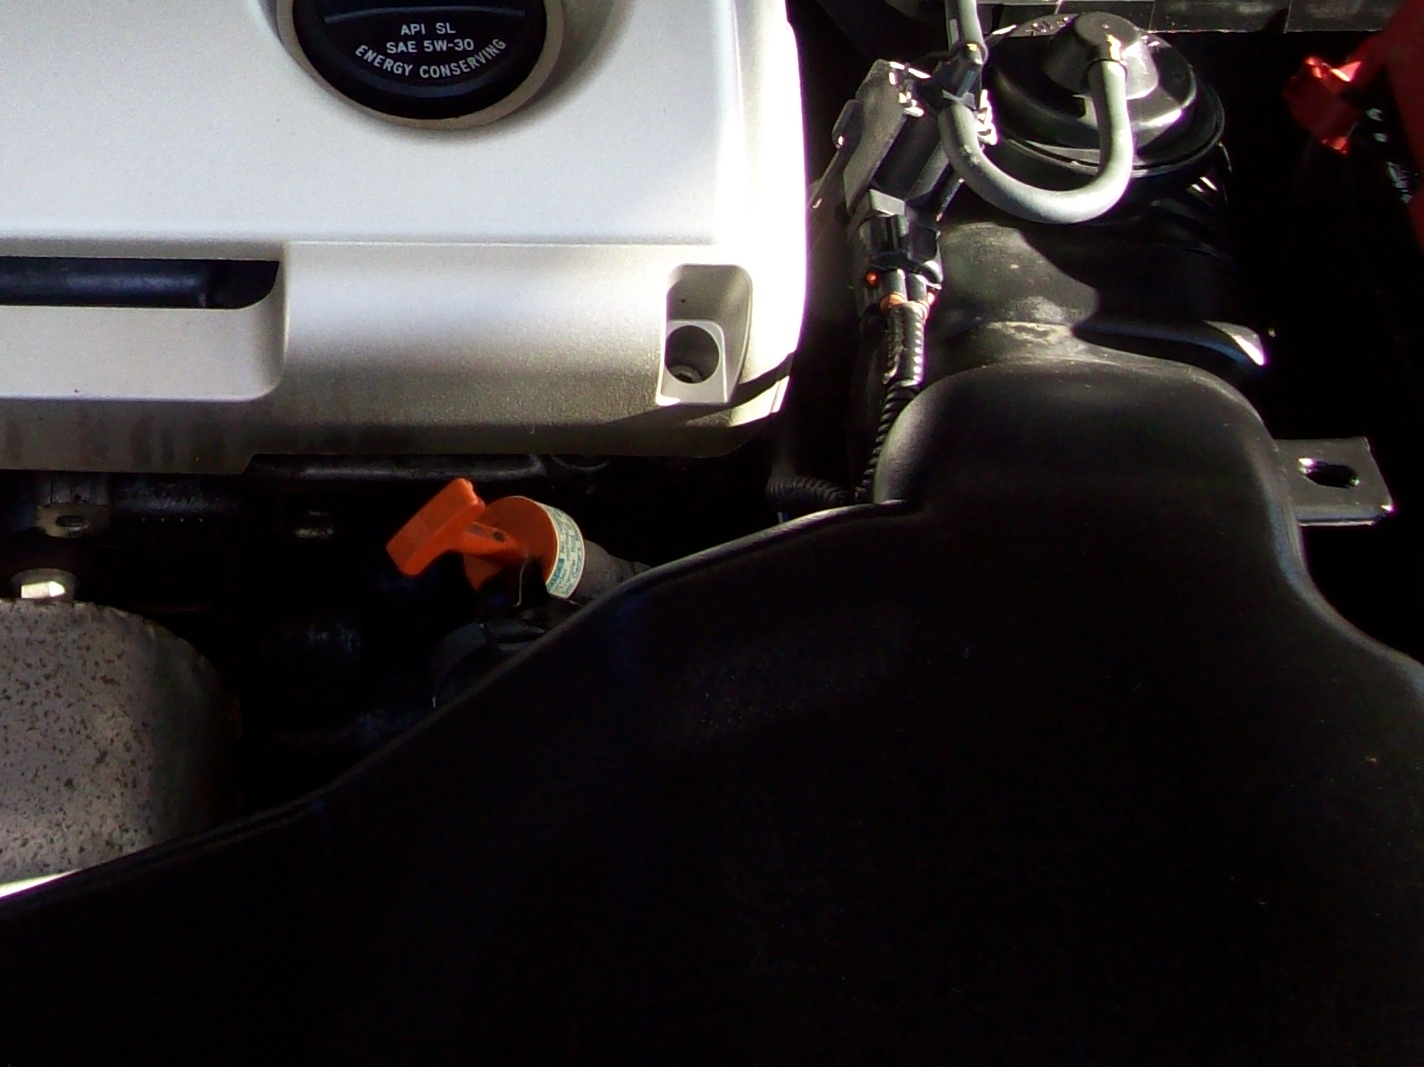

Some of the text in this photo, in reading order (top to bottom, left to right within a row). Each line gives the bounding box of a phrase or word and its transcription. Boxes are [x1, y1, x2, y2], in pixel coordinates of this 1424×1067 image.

[400, 22, 457, 35] API SL
[385, 38, 475, 54] SAE 5W-30
[354, 38, 507, 79] ENERGY CONSERVING
